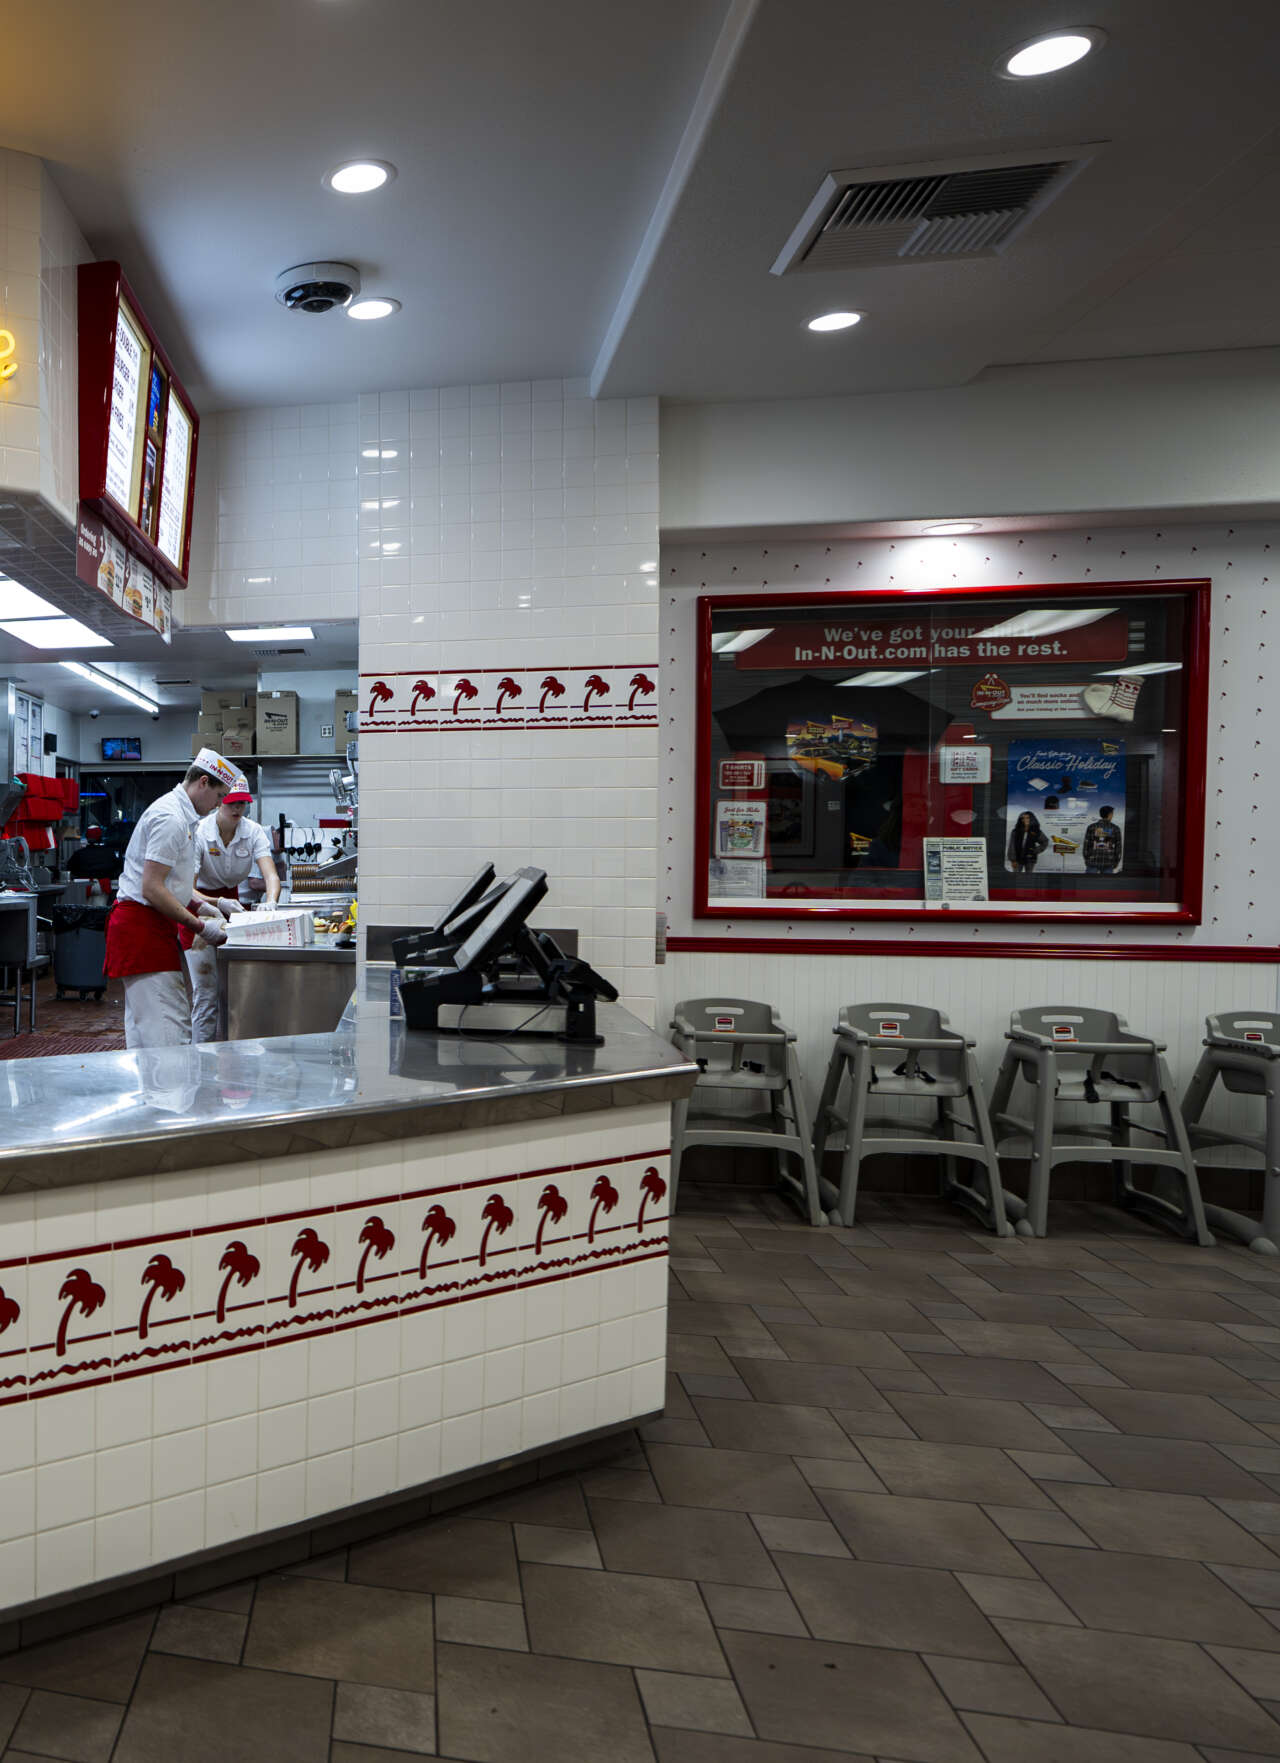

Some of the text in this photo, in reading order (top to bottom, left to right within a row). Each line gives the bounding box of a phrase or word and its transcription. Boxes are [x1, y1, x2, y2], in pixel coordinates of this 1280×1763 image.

[823, 627, 883, 643] We've
[889, 626, 923, 644] got
[930, 626, 976, 644] your
[794, 640, 1068, 661] In-N-Out.com has the rest.
[1017, 755, 1117, 779] Classic Holiday
